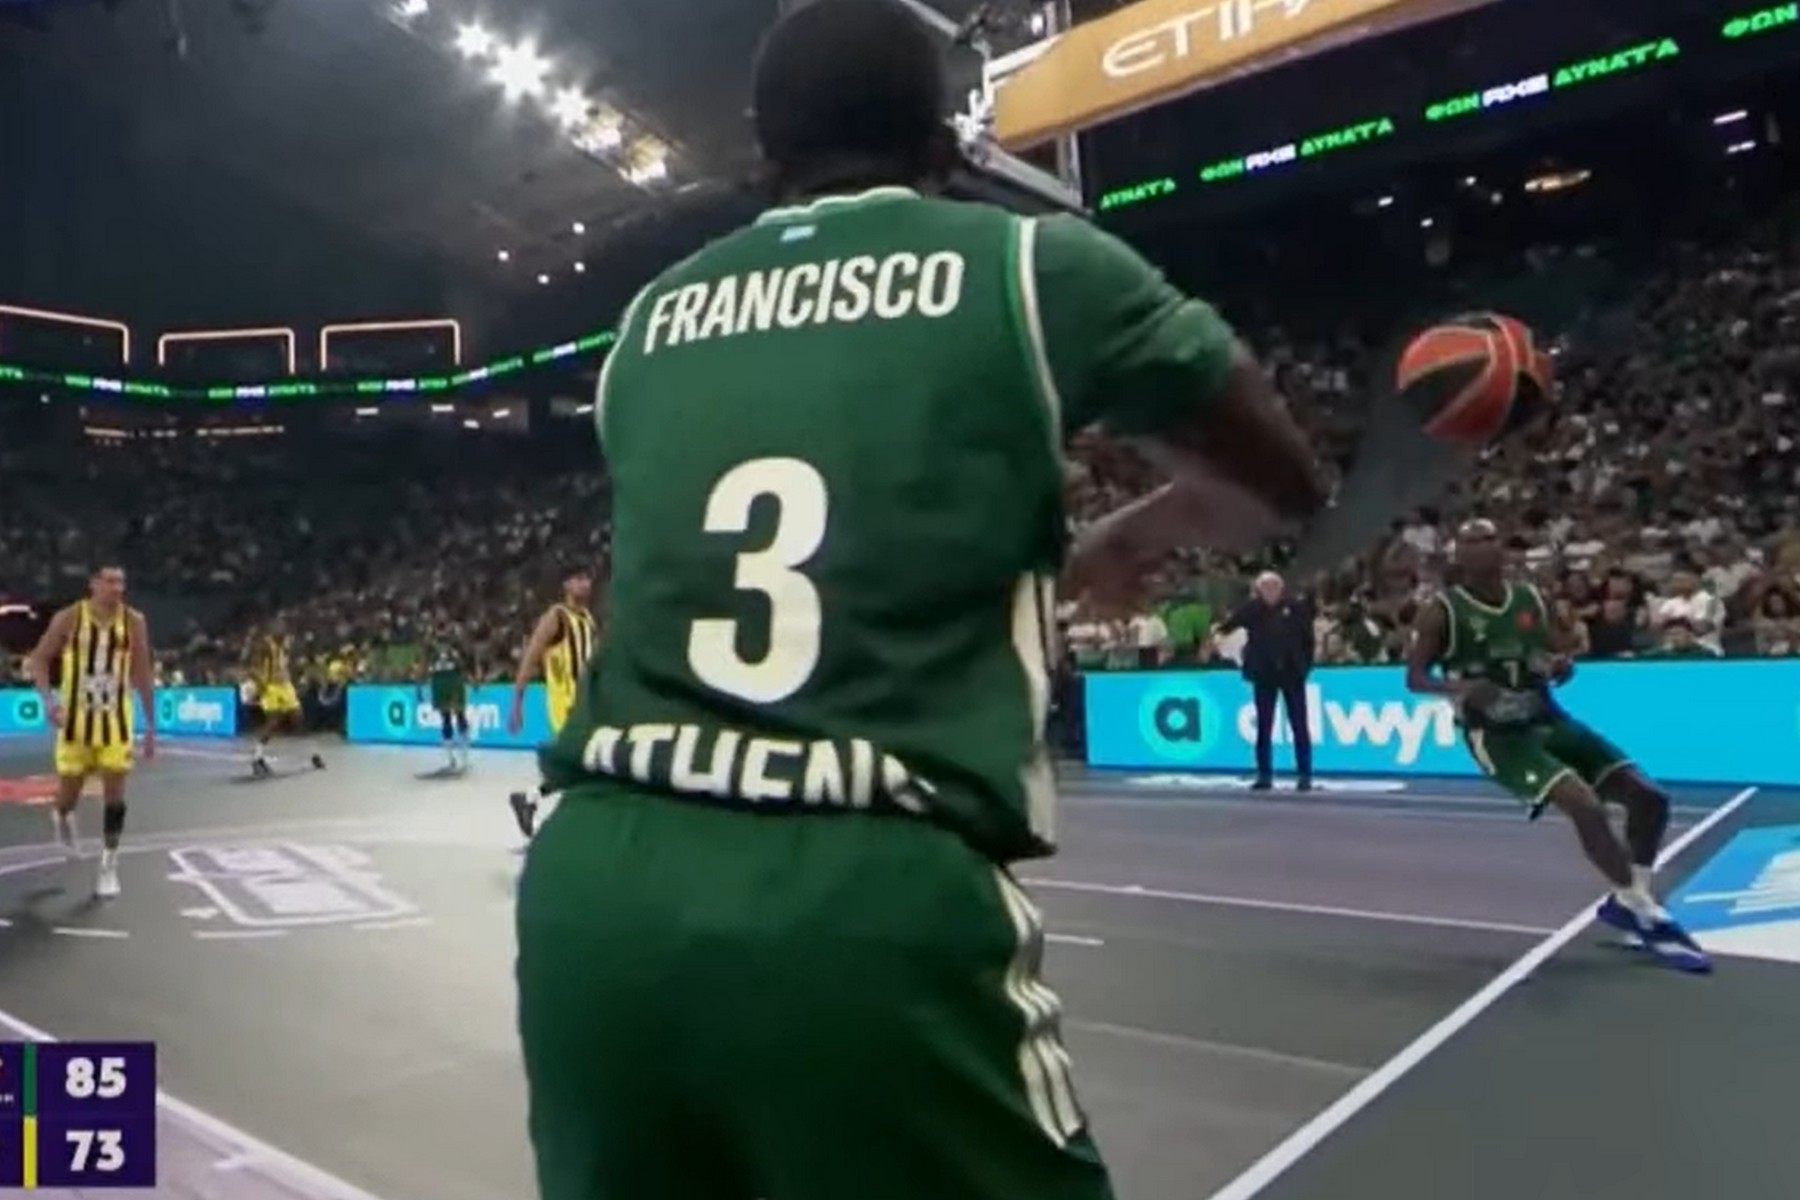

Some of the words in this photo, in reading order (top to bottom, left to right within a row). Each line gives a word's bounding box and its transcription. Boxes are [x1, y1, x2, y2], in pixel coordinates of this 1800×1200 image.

[1102, 0, 1306, 77] ETIH
[643, 251, 965, 355] FRANCISCO
[688, 457, 827, 704] 3
[1237, 683, 1456, 765] alwy
